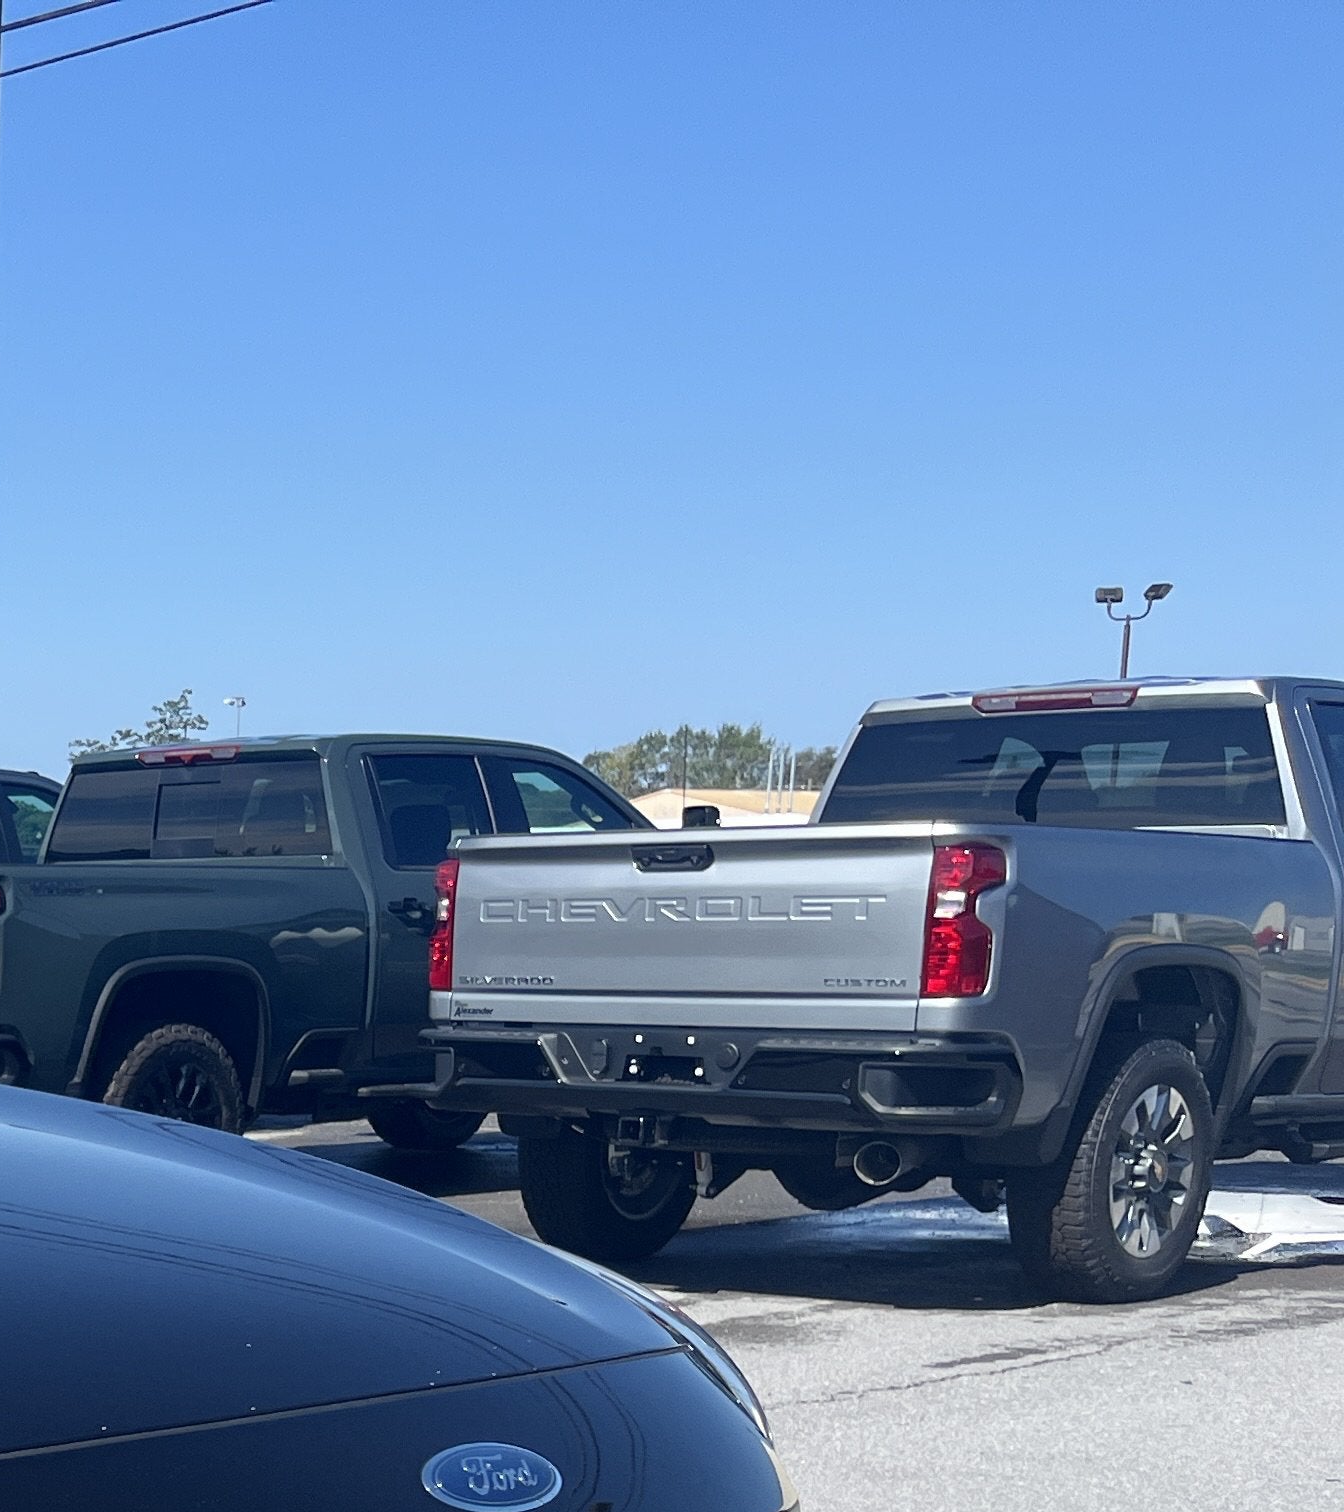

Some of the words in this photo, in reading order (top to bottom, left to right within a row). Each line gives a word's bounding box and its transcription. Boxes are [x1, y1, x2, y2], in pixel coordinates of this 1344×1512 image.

[479, 894, 888, 922] CHEVROLET
[458, 975, 554, 985] SILVERADO
[823, 978, 907, 987] CUSTOM
[461, 1453, 538, 1496] Ford
